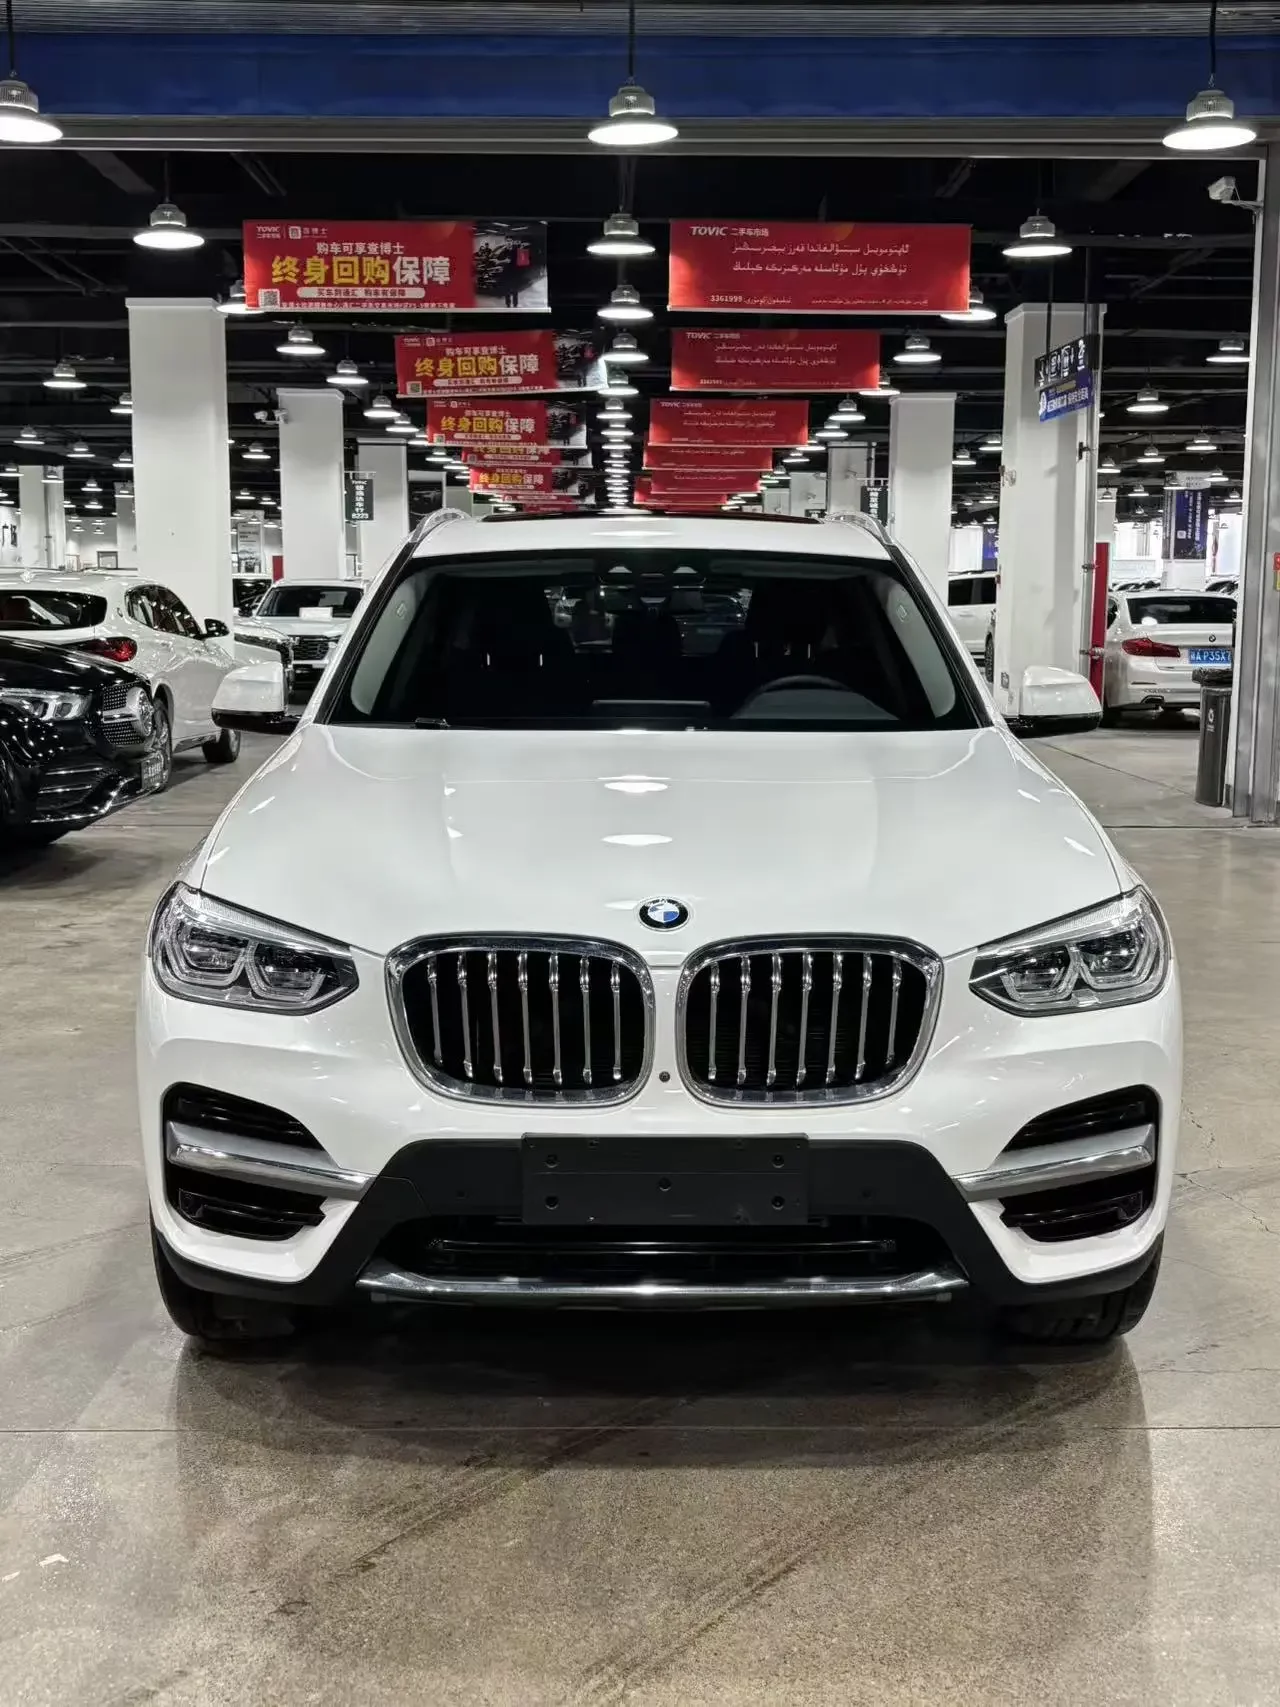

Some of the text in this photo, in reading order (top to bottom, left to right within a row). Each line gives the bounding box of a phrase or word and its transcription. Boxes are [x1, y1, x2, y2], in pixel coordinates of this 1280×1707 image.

[690, 226, 728, 236] TOVIC
[316, 242, 405, 255] 购车可享查博士
[271, 255, 451, 285] 终身回购保障
[414, 353, 539, 377] 终身回购保障
[440, 415, 536, 434] 终身回购保障
